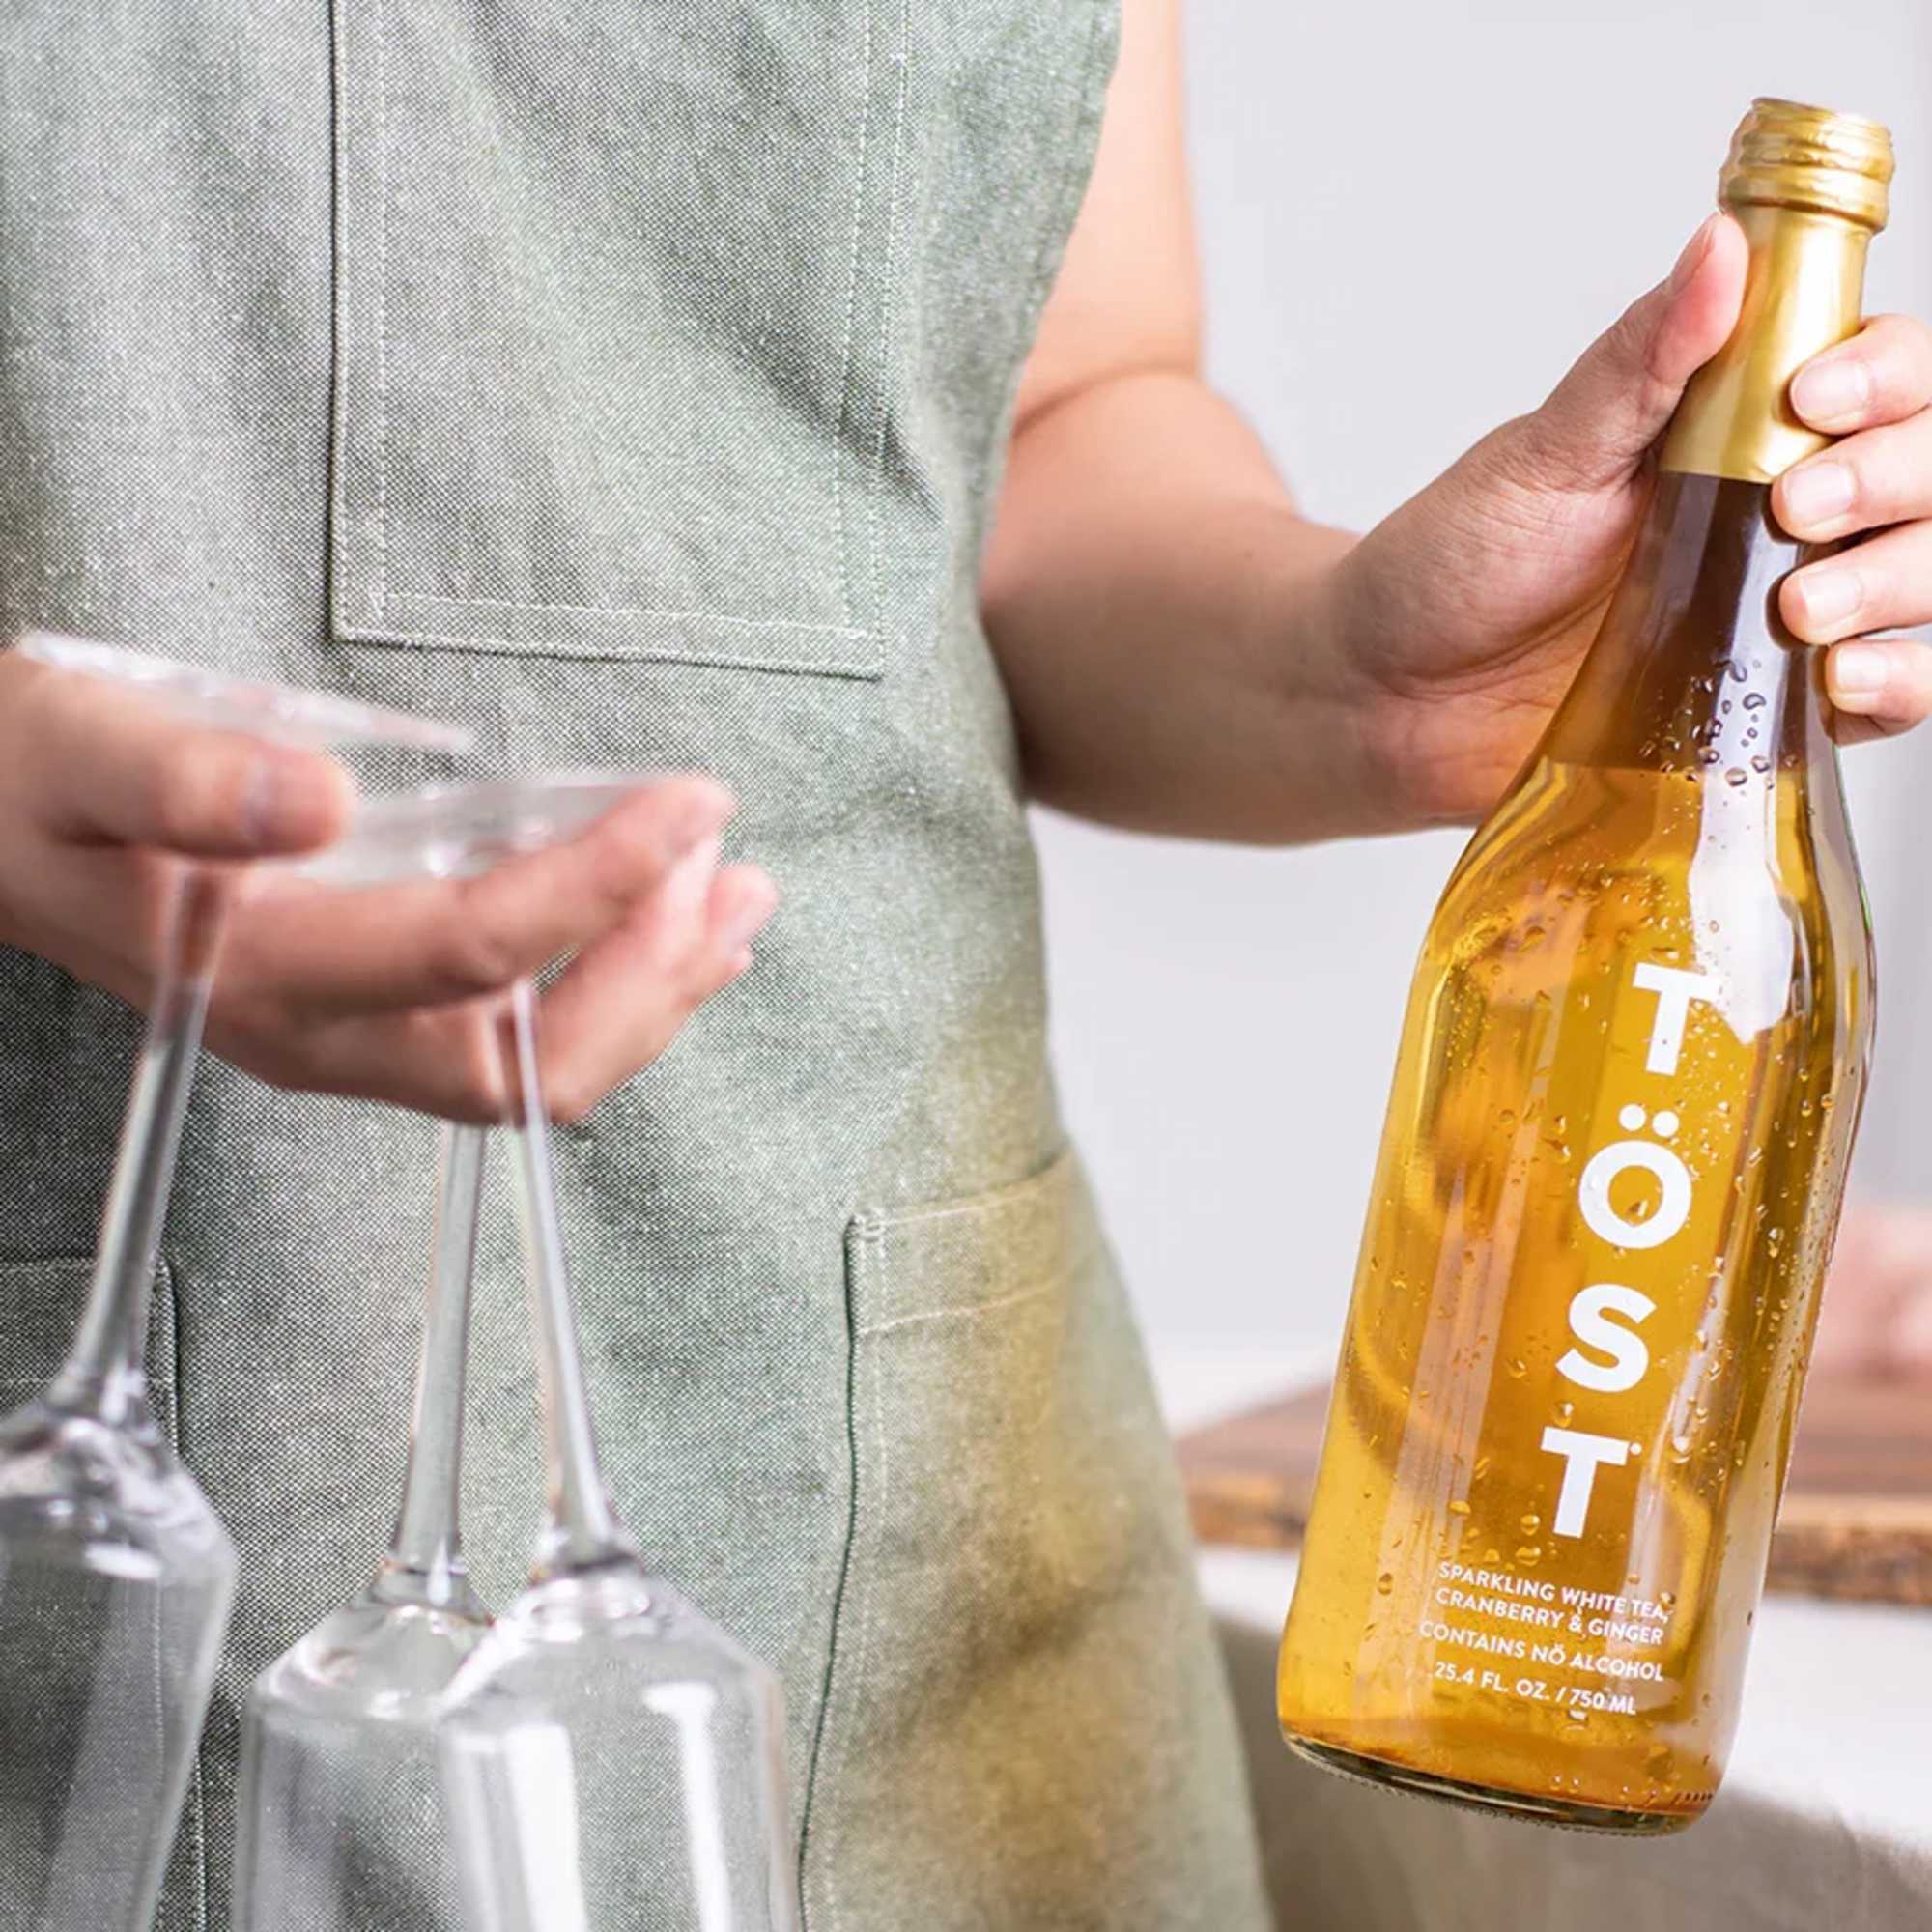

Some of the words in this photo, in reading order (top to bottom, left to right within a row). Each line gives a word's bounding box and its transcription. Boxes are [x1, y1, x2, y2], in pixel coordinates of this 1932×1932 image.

[1435, 1587, 1566, 1629] CRANBERRY
[1568, 1614, 1582, 1633] &
[1588, 1618, 1664, 1645] GINGER
[1438, 1561, 1555, 1602] SPARKLING
[1561, 1586, 1626, 1615] WHITE
[1419, 1620, 1525, 1659] CONTAINS
[1531, 1643, 1566, 1665] NÖ
[1569, 1652, 1664, 1682] ALCOHOL
[1435, 1661, 1474, 1685] 25.4
[1480, 1671, 1509, 1692] FL.
[1516, 1678, 1550, 1701] OZ.
[1570, 1689, 1605, 1710] 750
[1607, 1695, 1637, 1716] ML
